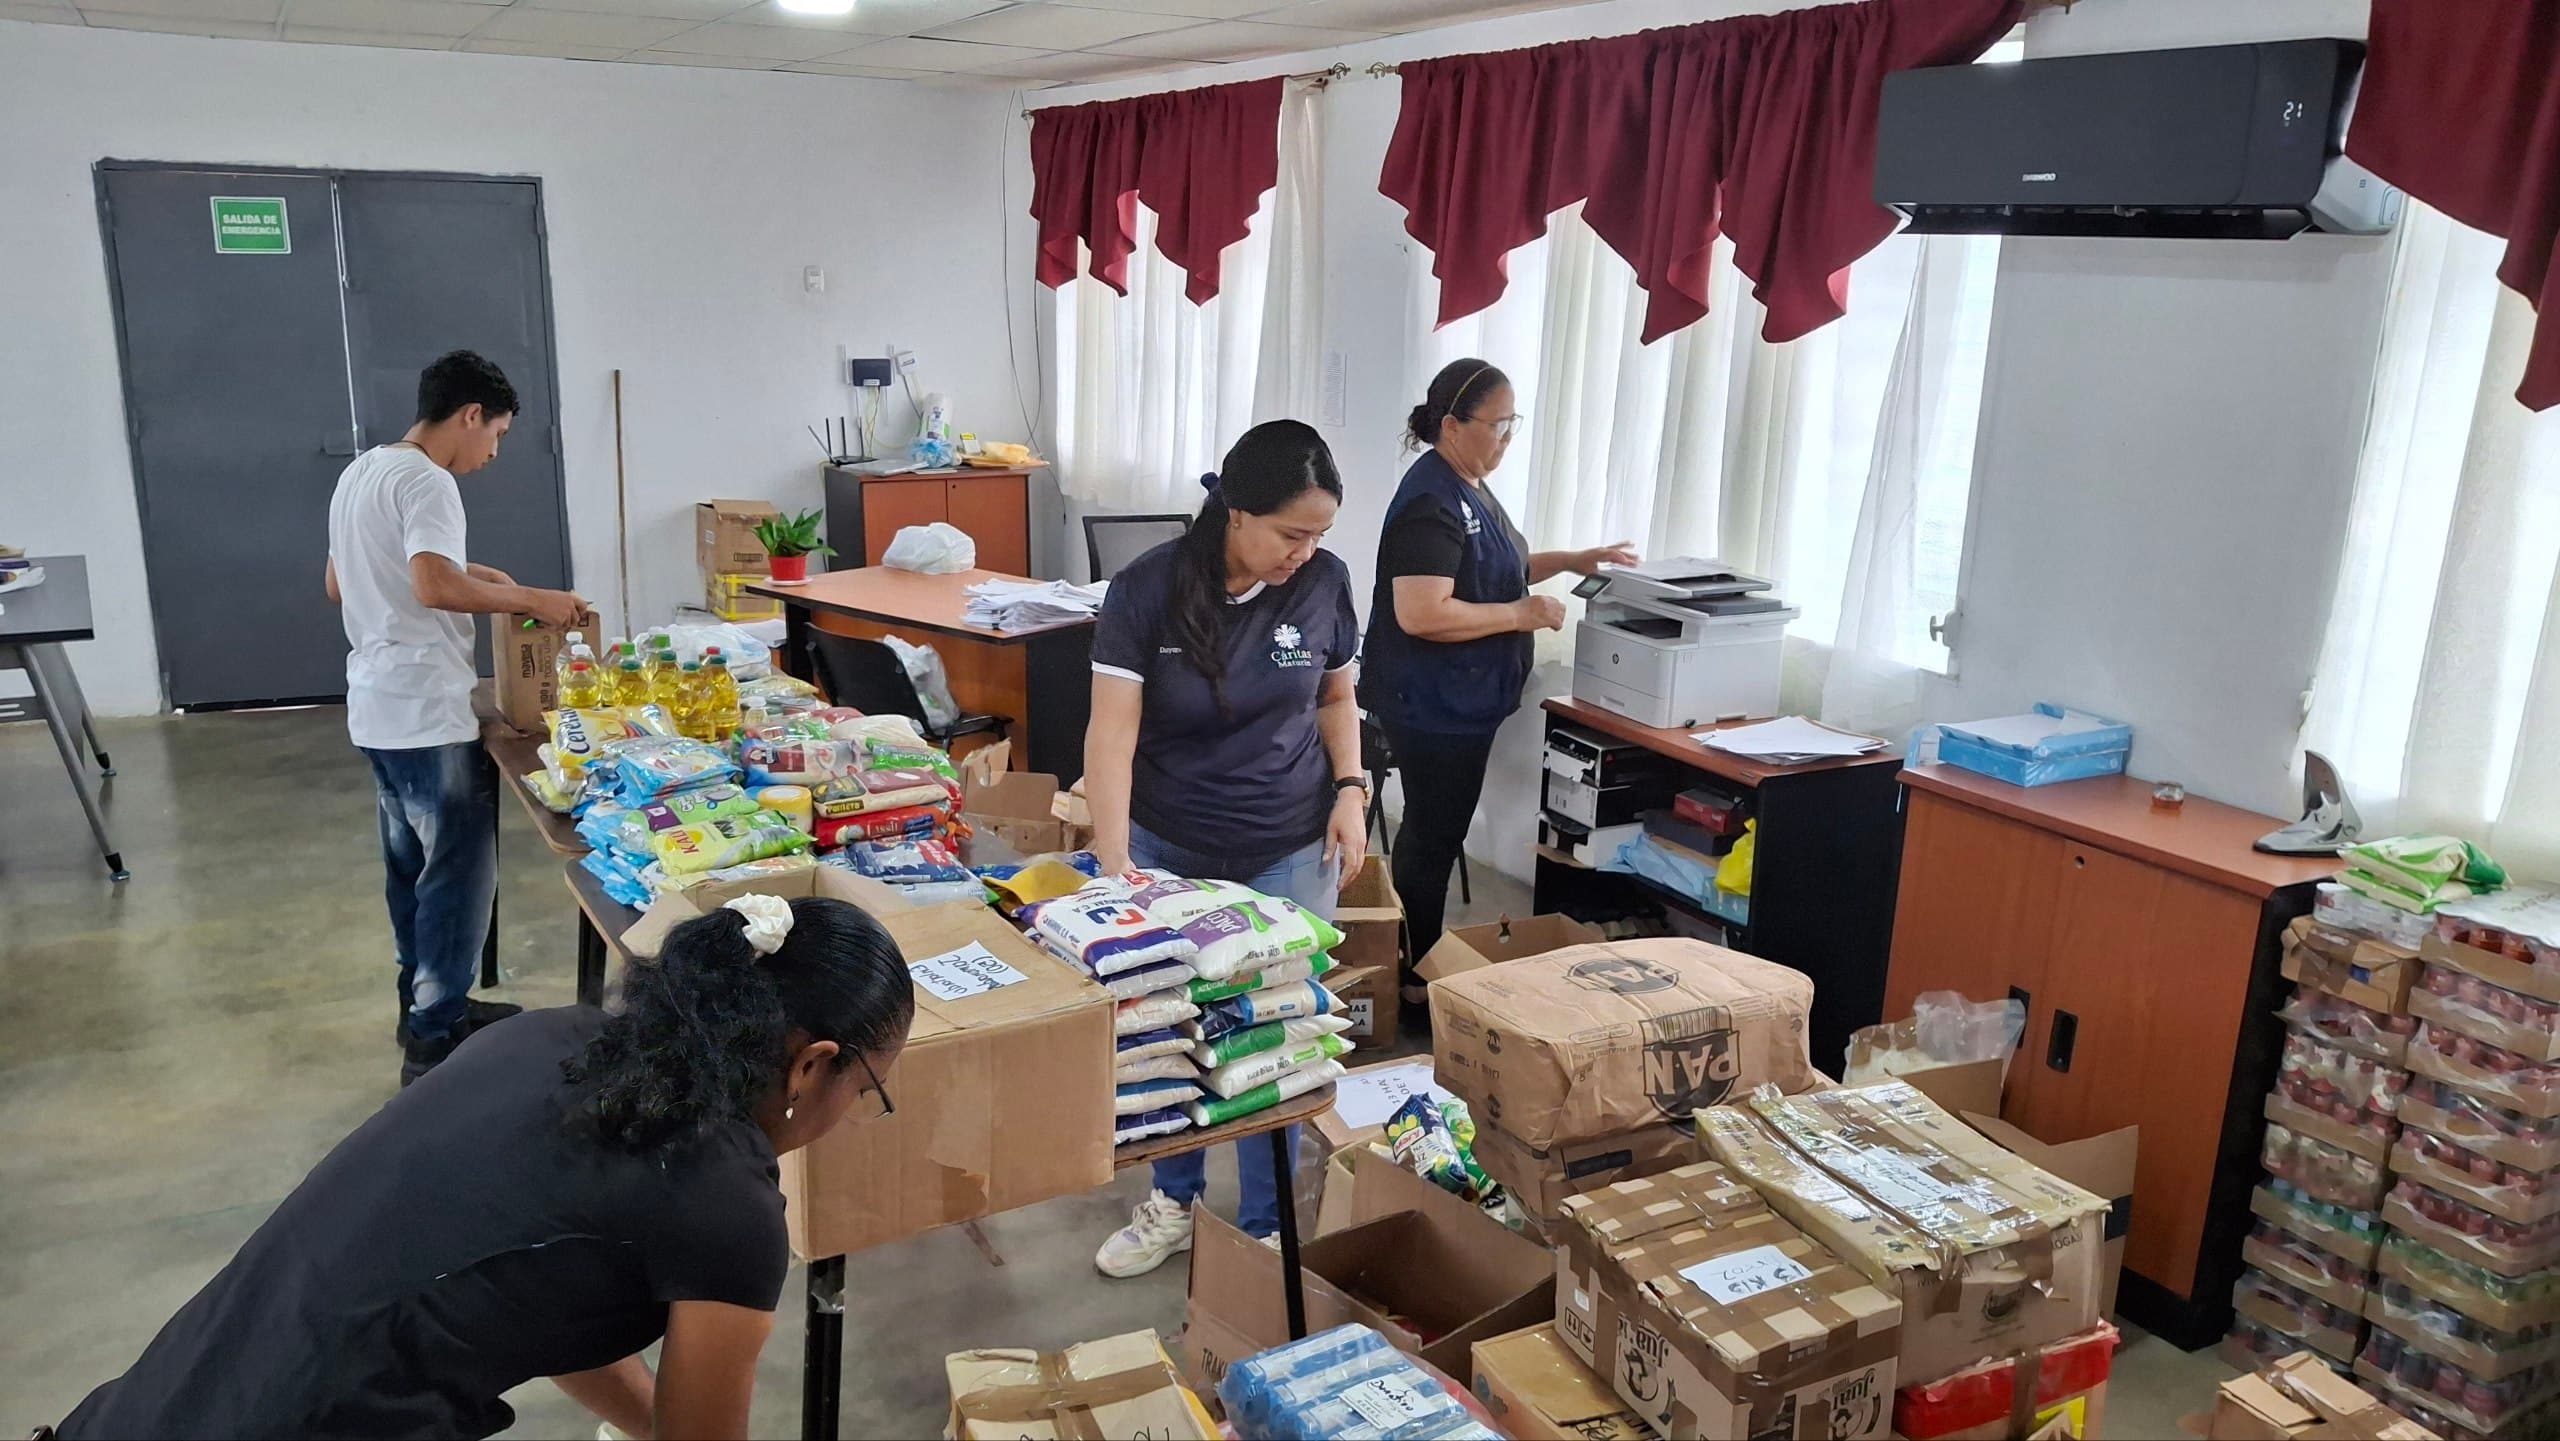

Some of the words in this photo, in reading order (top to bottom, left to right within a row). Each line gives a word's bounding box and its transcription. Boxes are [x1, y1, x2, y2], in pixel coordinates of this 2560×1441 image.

[2283, 101, 2303, 120] 21
[222, 214, 261, 224] SALIDA
[263, 215, 278, 224] DE
[222, 226, 281, 235] EMERGENCIA
[521, 643, 532, 679] mavesa
[1271, 650, 1312, 662] Cáritas
